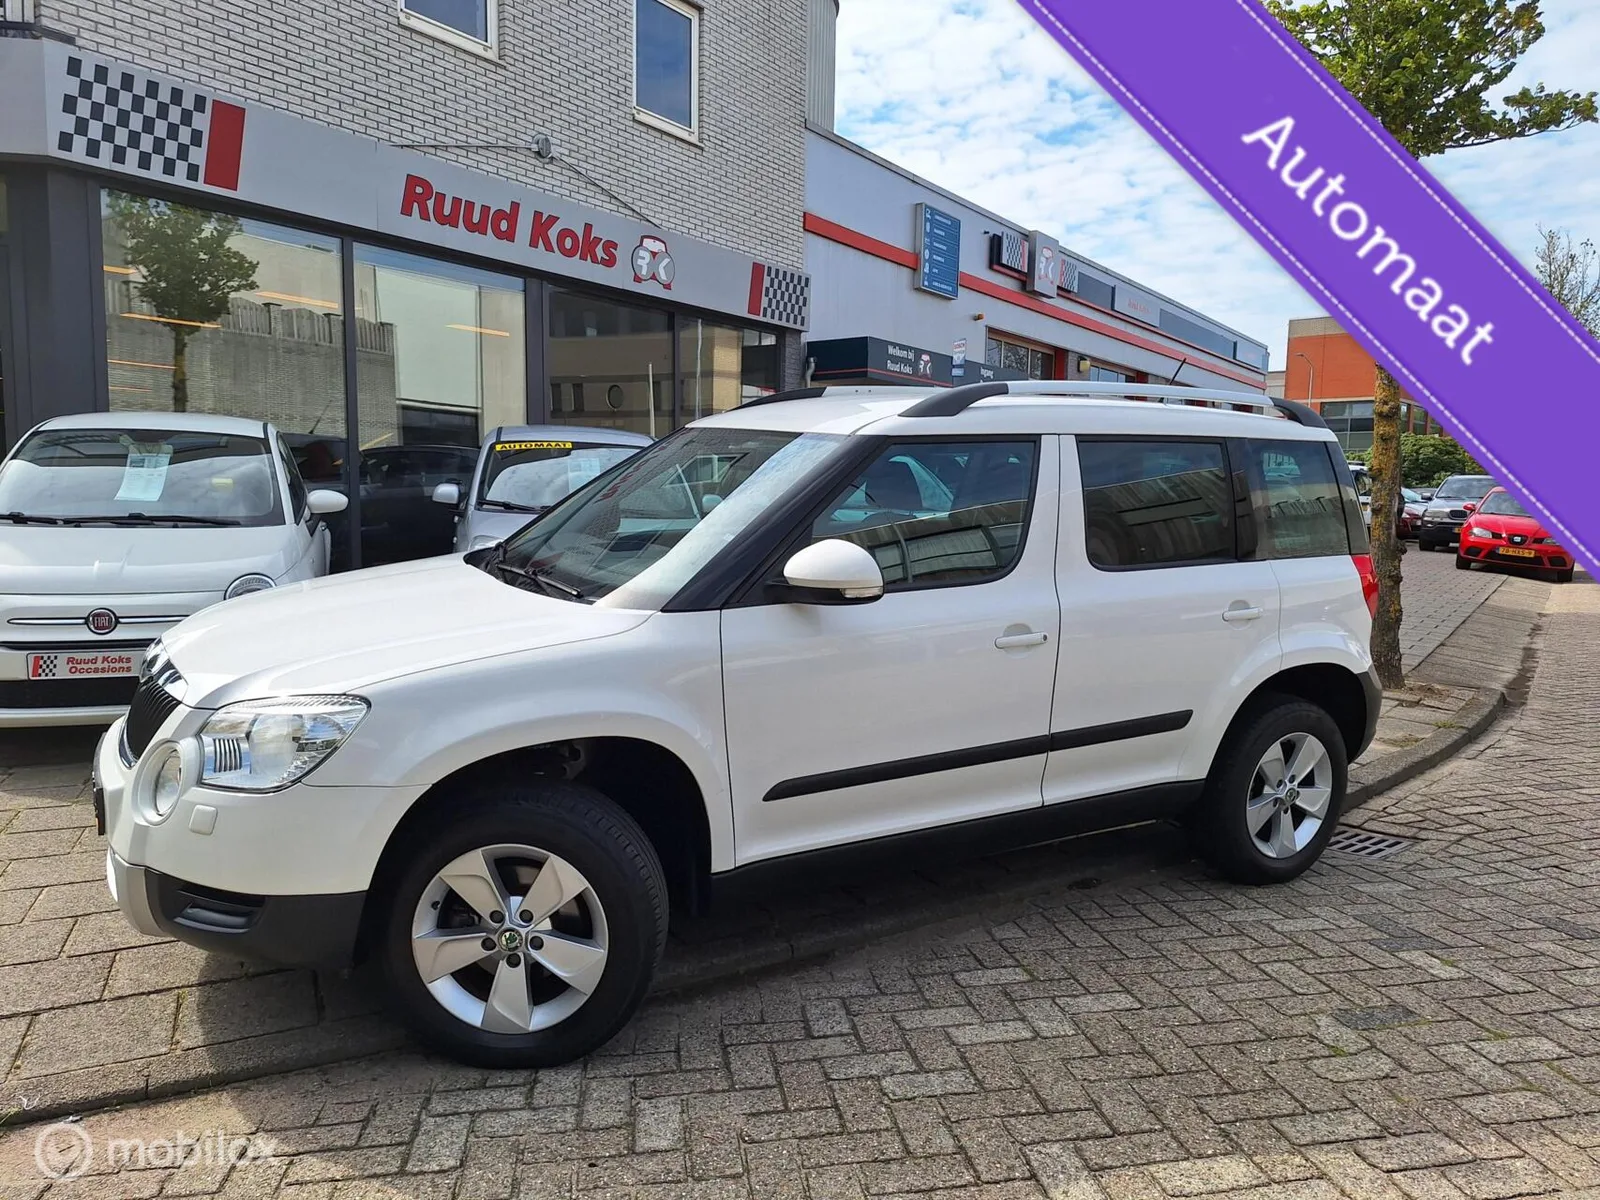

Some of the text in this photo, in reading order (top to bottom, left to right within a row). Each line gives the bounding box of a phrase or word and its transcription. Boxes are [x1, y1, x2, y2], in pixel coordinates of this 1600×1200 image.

[400, 173, 619, 269] Ruud Koks
[887, 344, 908, 358] Welkom
[886, 359, 913, 375] Ruud Koks
[500, 442, 568, 450] AUTOMAAT
[94, 616, 109, 627] FIAT
[66, 655, 132, 665] Ruud Koks
[69, 665, 132, 674] Occasions
